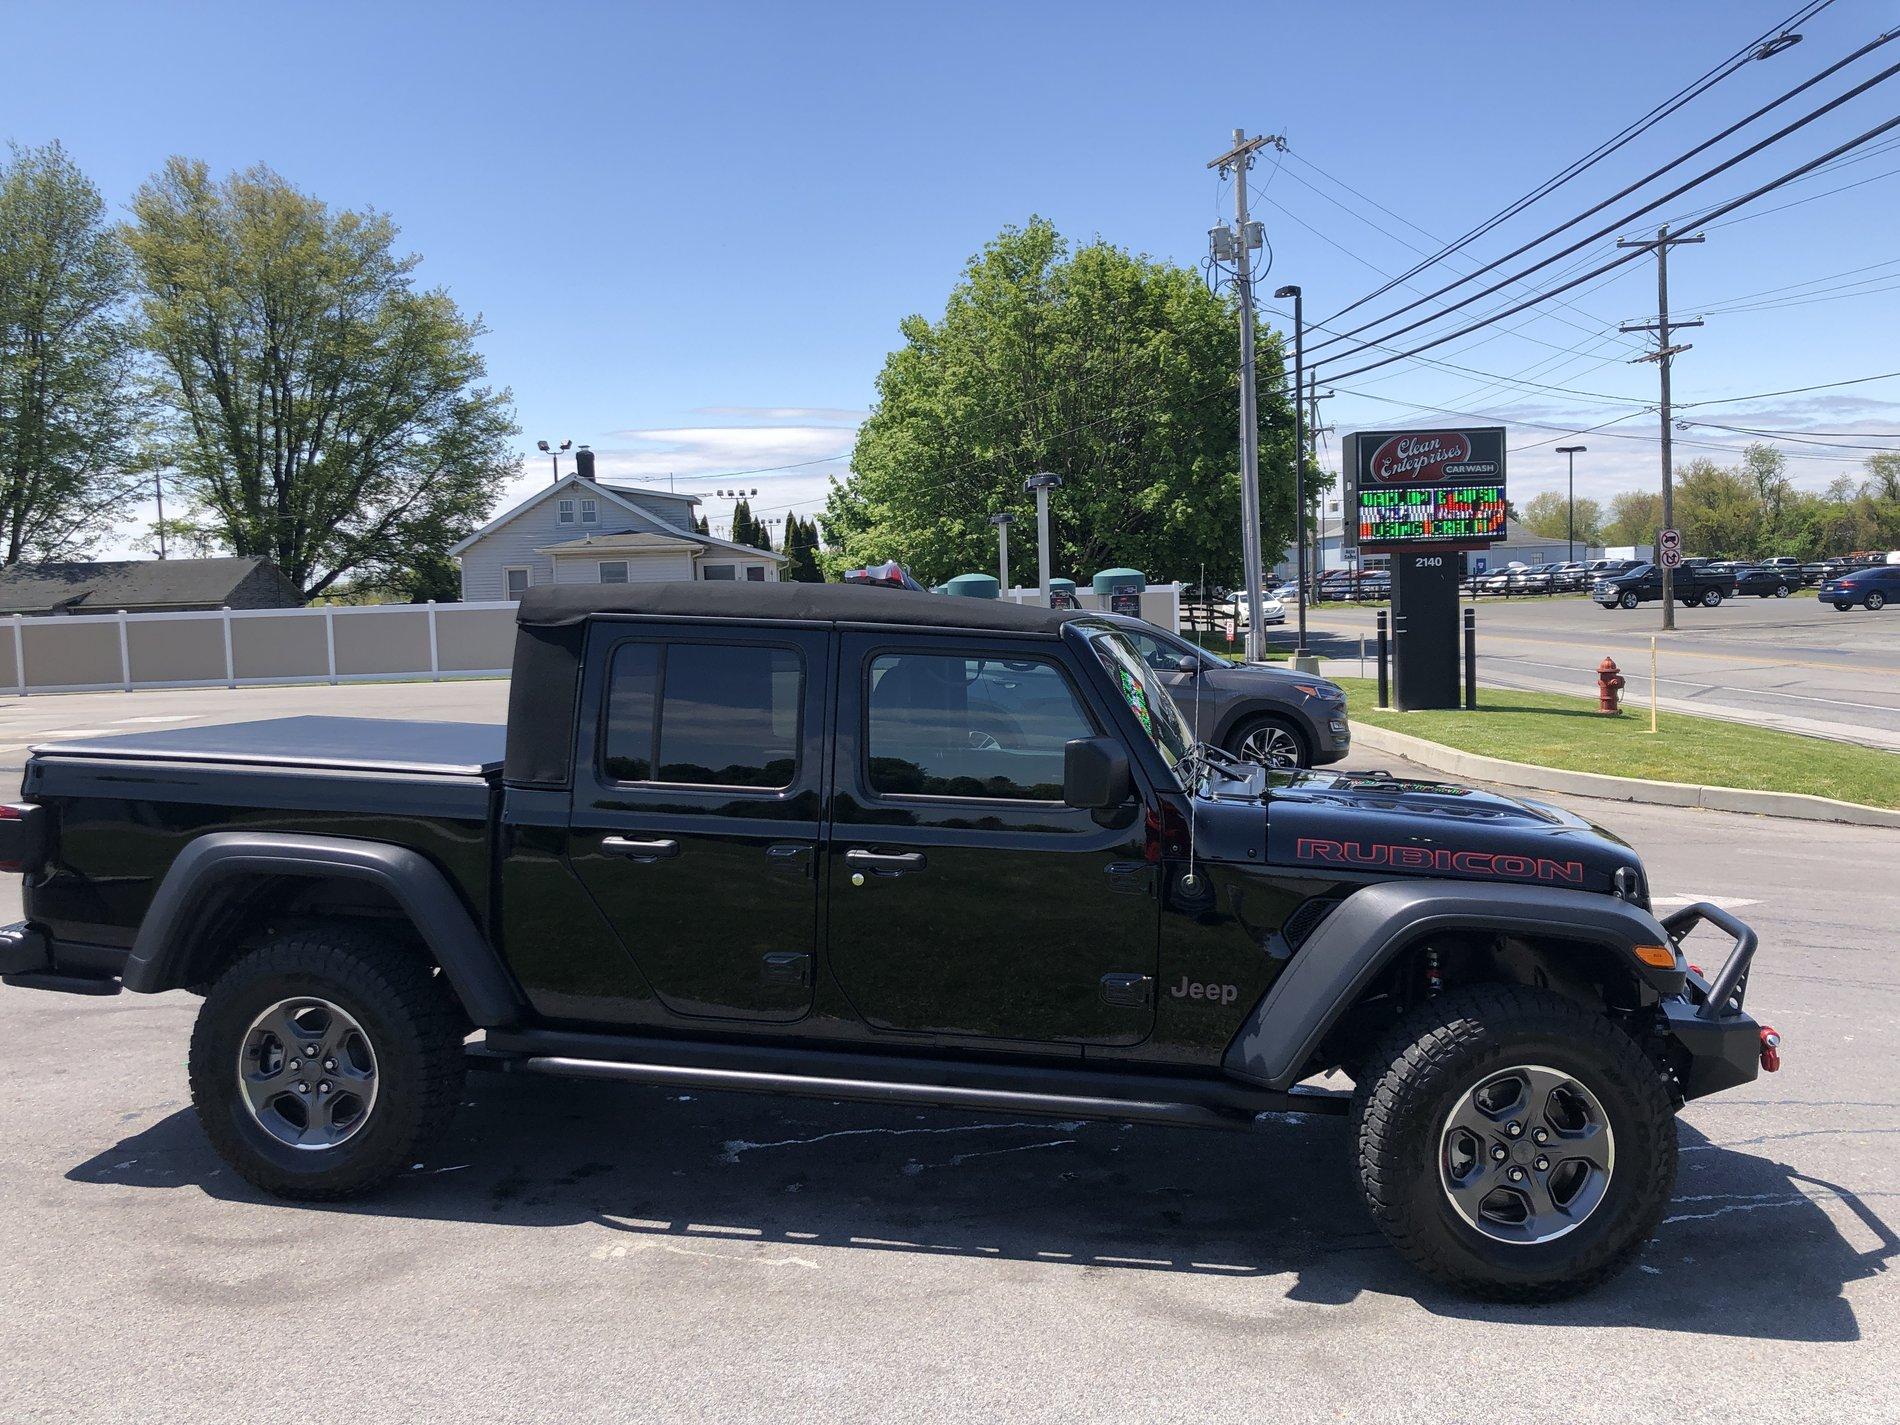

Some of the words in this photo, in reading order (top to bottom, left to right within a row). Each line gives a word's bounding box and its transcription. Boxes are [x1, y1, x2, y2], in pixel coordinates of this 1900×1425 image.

[1397, 437, 1441, 459] Clean
[1381, 445, 1463, 478] Enterprises
[1446, 465, 1465, 473] CAR
[1466, 464, 1494, 473] WASH
[1415, 557, 1442, 567] 2140
[1297, 838, 1583, 882] RUBICON
[1171, 976, 1238, 1005] Jeep
